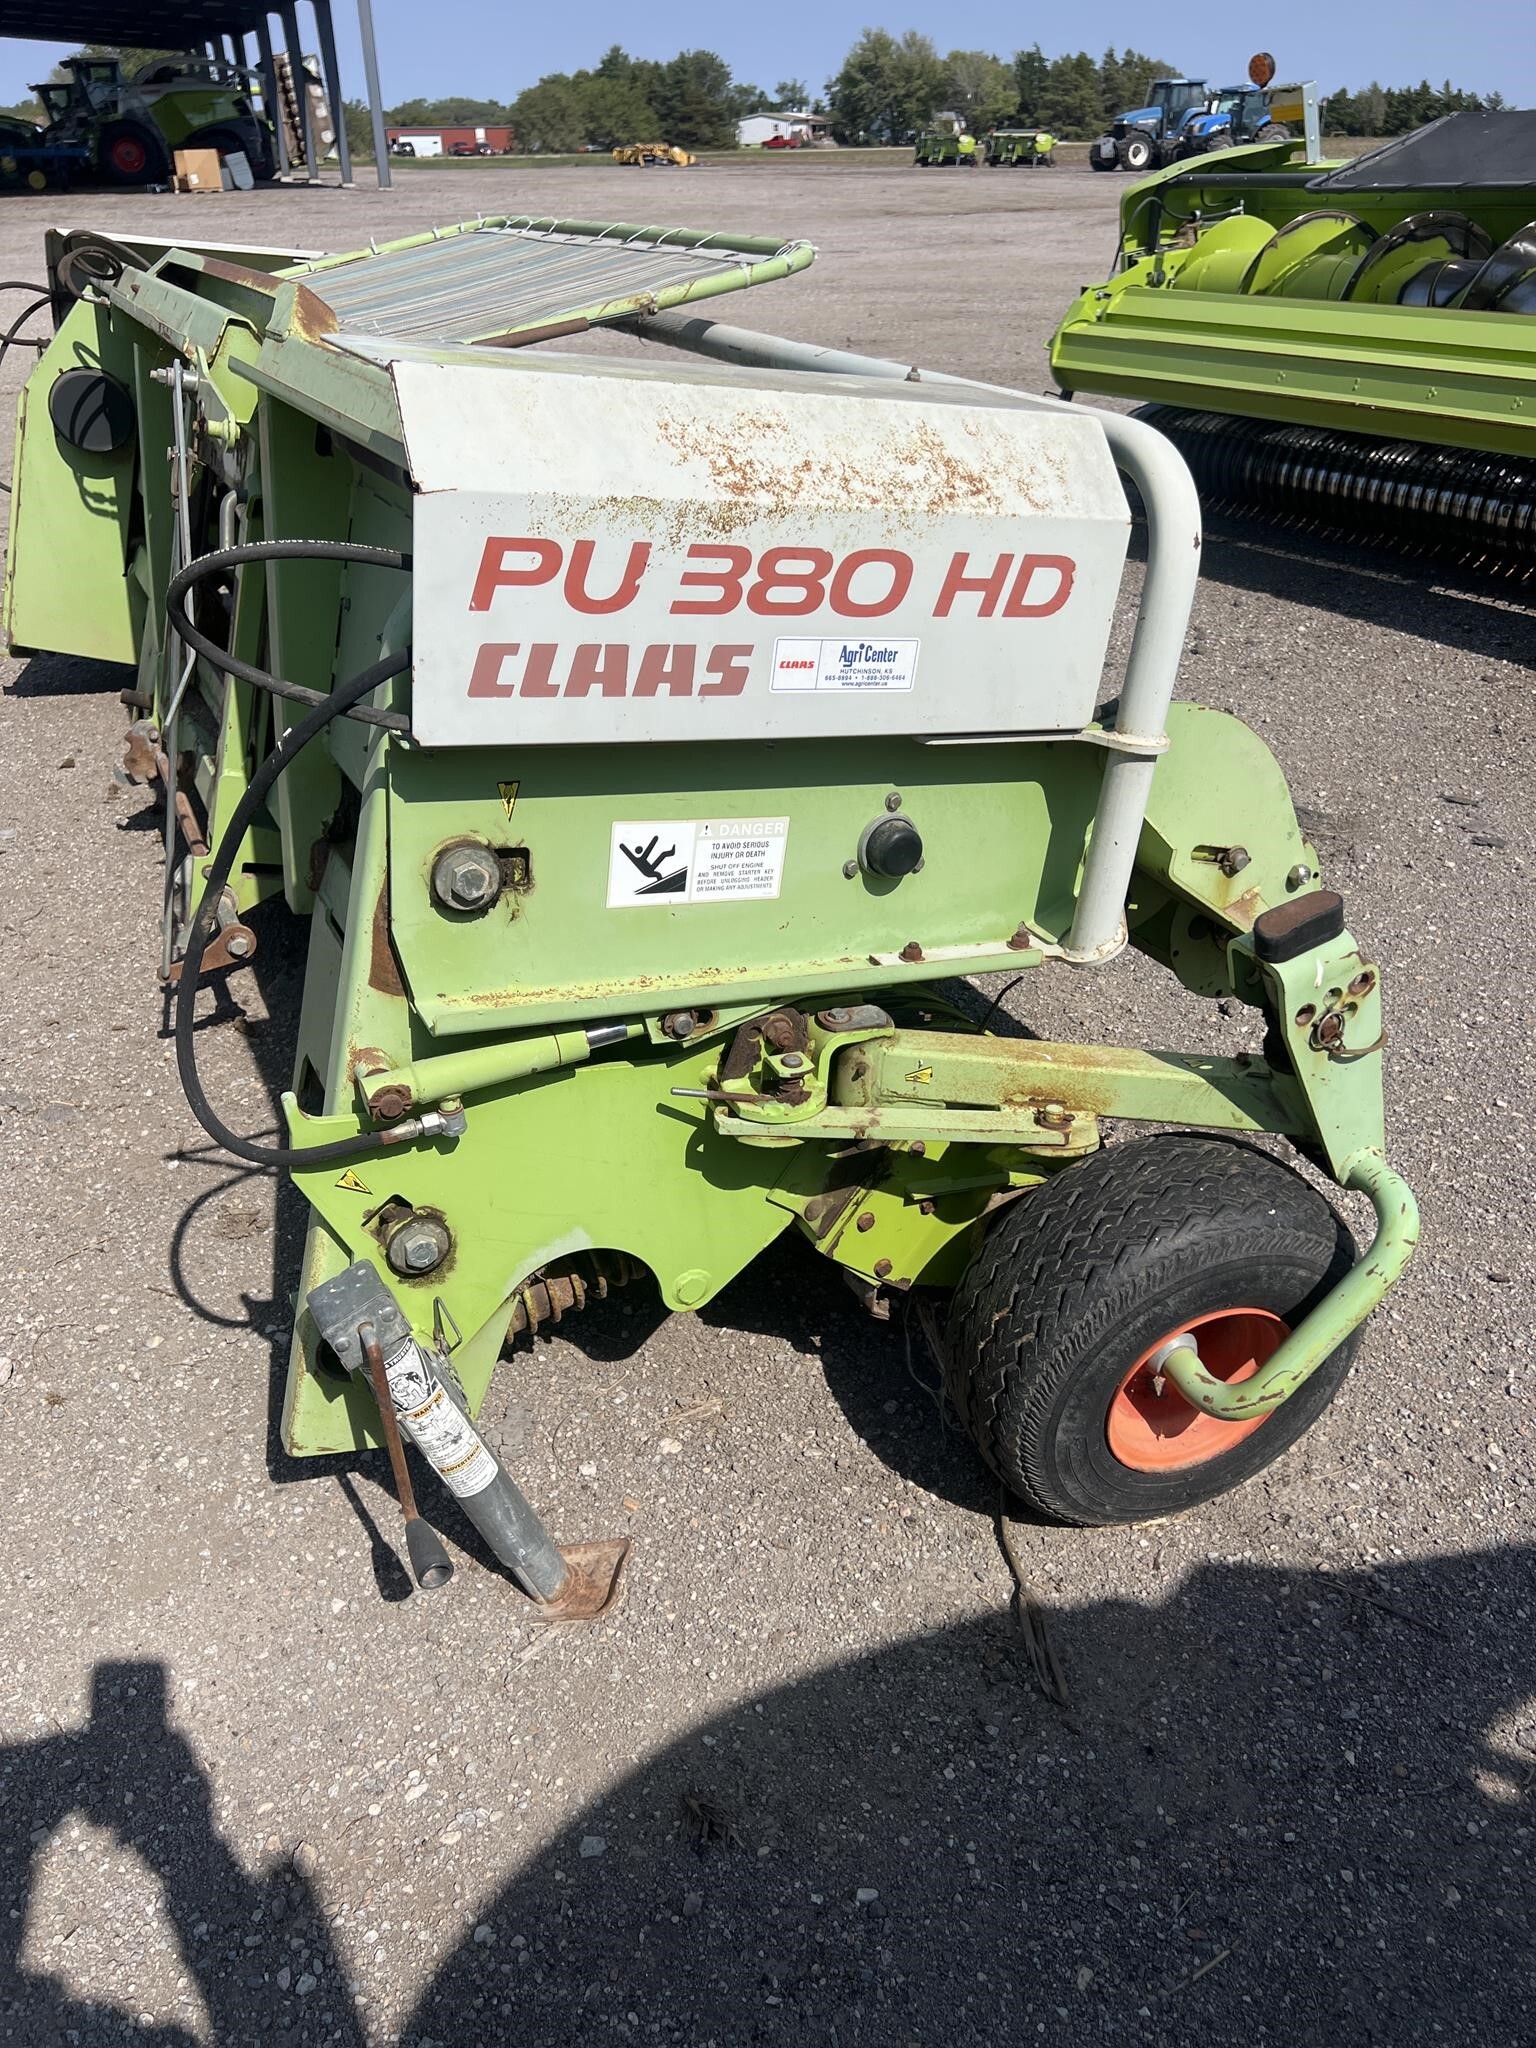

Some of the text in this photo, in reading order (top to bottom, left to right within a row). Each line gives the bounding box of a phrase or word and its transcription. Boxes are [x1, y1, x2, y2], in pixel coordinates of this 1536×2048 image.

[468, 536, 652, 615] PU
[669, 544, 914, 618] 380
[932, 552, 1077, 618] HD
[467, 642, 754, 698] CLAAS
[779, 660, 815, 669] CLAAS
[719, 822, 784, 836] DANGER
[710, 851, 734, 859] INJURY
[746, 850, 766, 858] DEATH
[727, 862, 740, 870] OFF
[741, 861, 764, 869] ENGINE
[446, 1444, 480, 1473] ADVERTENCIA
